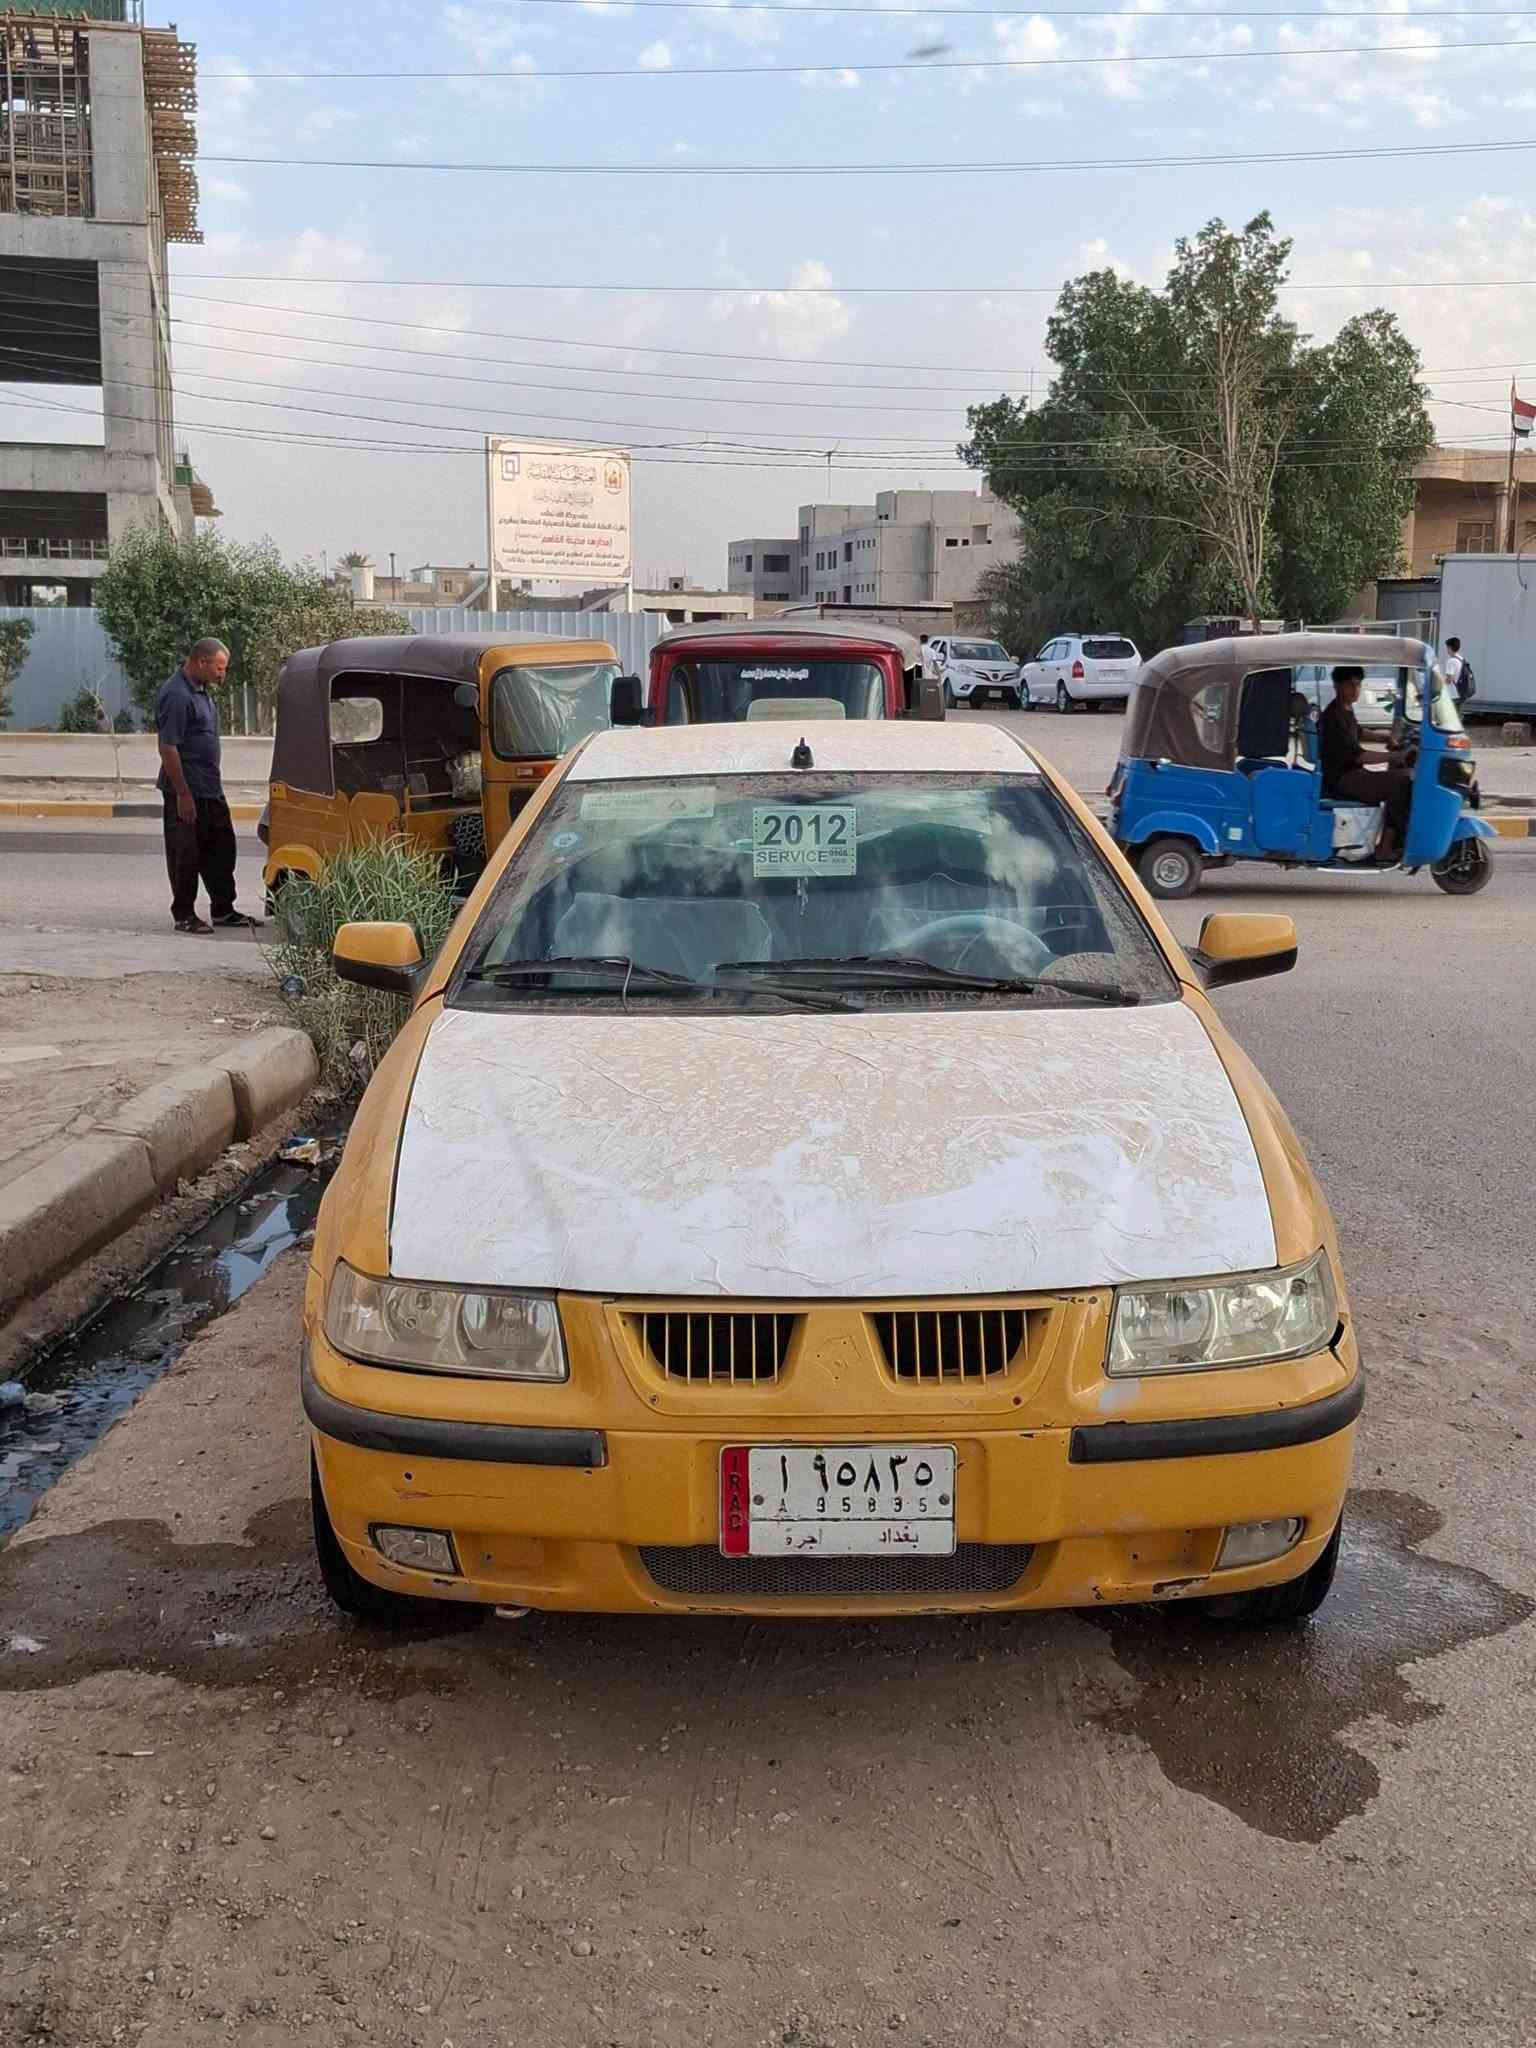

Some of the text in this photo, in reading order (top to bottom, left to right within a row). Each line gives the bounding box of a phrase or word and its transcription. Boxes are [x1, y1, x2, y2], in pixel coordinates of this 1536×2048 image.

[761, 814, 847, 846] 2012
[757, 850, 828, 864] SERVICE
[729, 1455, 741, 1531] IRAQ
[880, 1525, 919, 1549] بغداد
